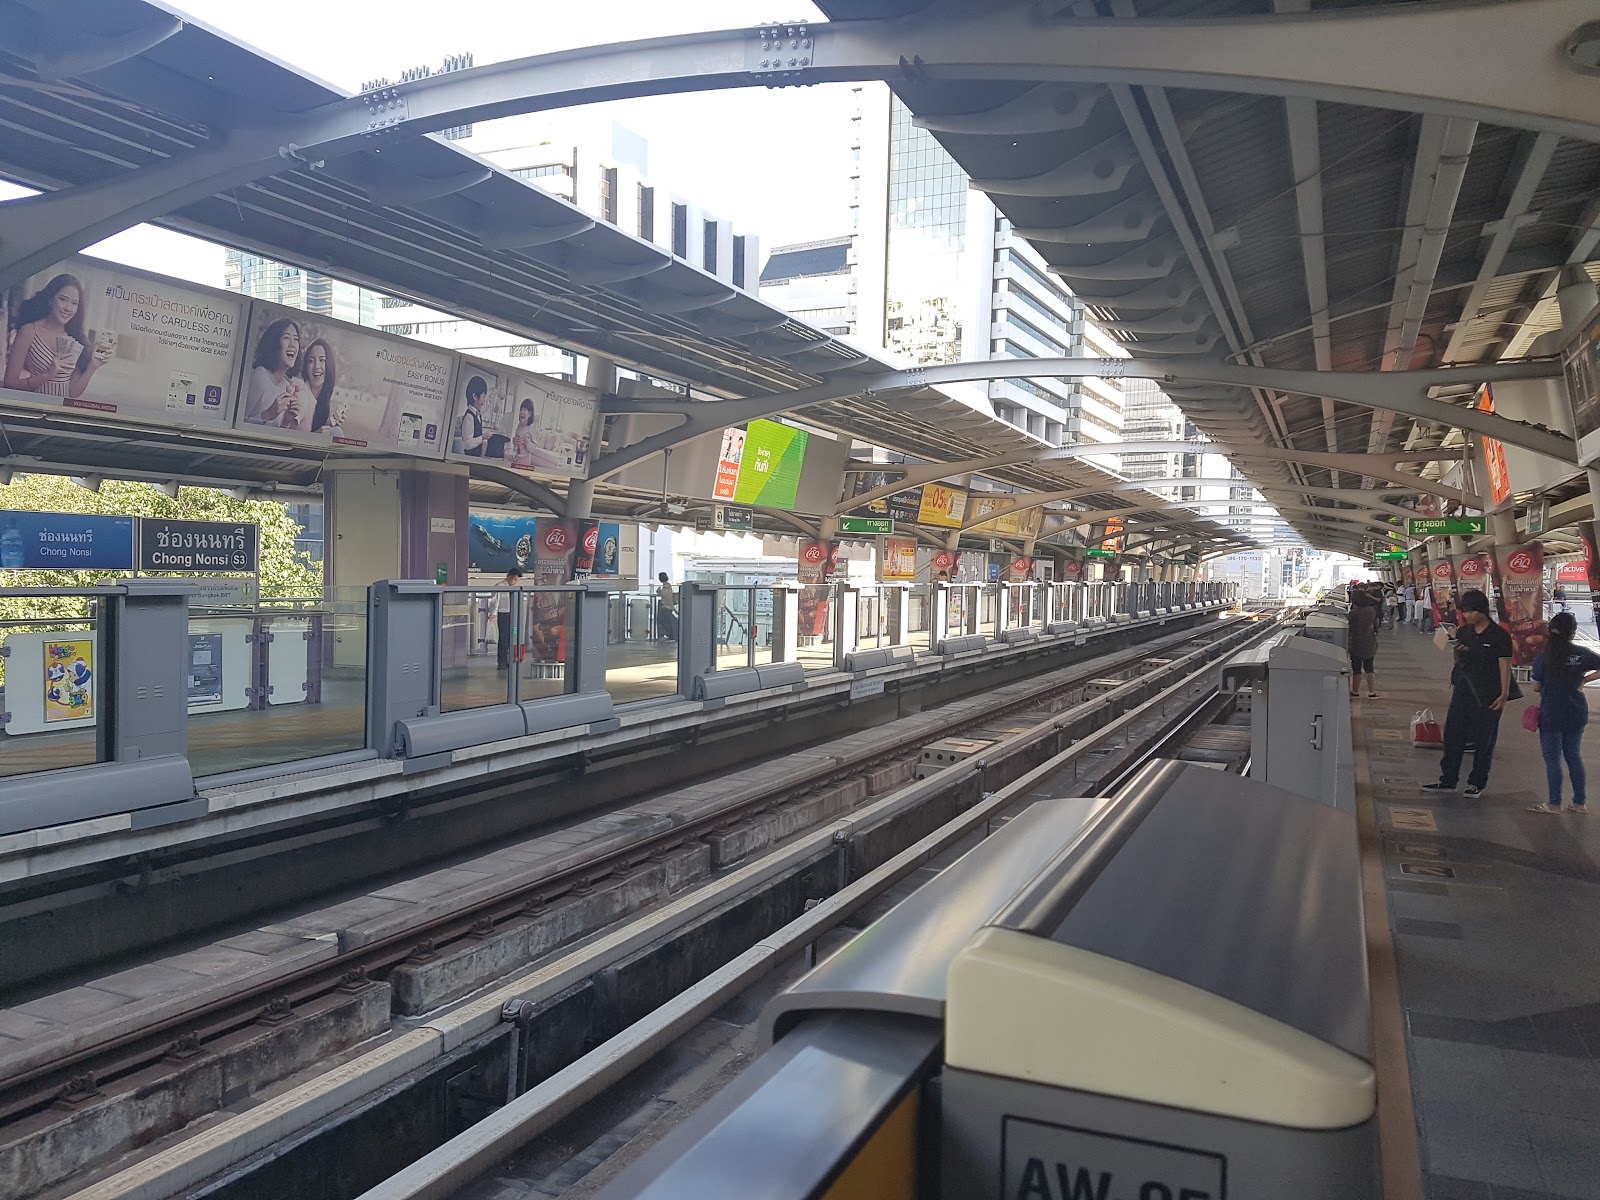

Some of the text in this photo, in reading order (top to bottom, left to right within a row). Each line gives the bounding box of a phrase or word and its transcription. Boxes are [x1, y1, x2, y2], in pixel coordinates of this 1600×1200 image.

[132, 308, 232, 338] EASY CARDLESS ATM
[213, 349, 228, 357] EASY
[407, 370, 423, 381] EASY
[424, 374, 446, 386] BONUS
[866, 520, 889, 528] ทางออก
[1414, 519, 1446, 528] ทางออก
[39, 527, 93, 543] ช่องนนทรี
[156, 525, 246, 550] ช่องนนทรี
[40, 547, 92, 558] Chong Nonsi
[152, 552, 193, 567] Chong
[195, 553, 229, 566] Nonsi
